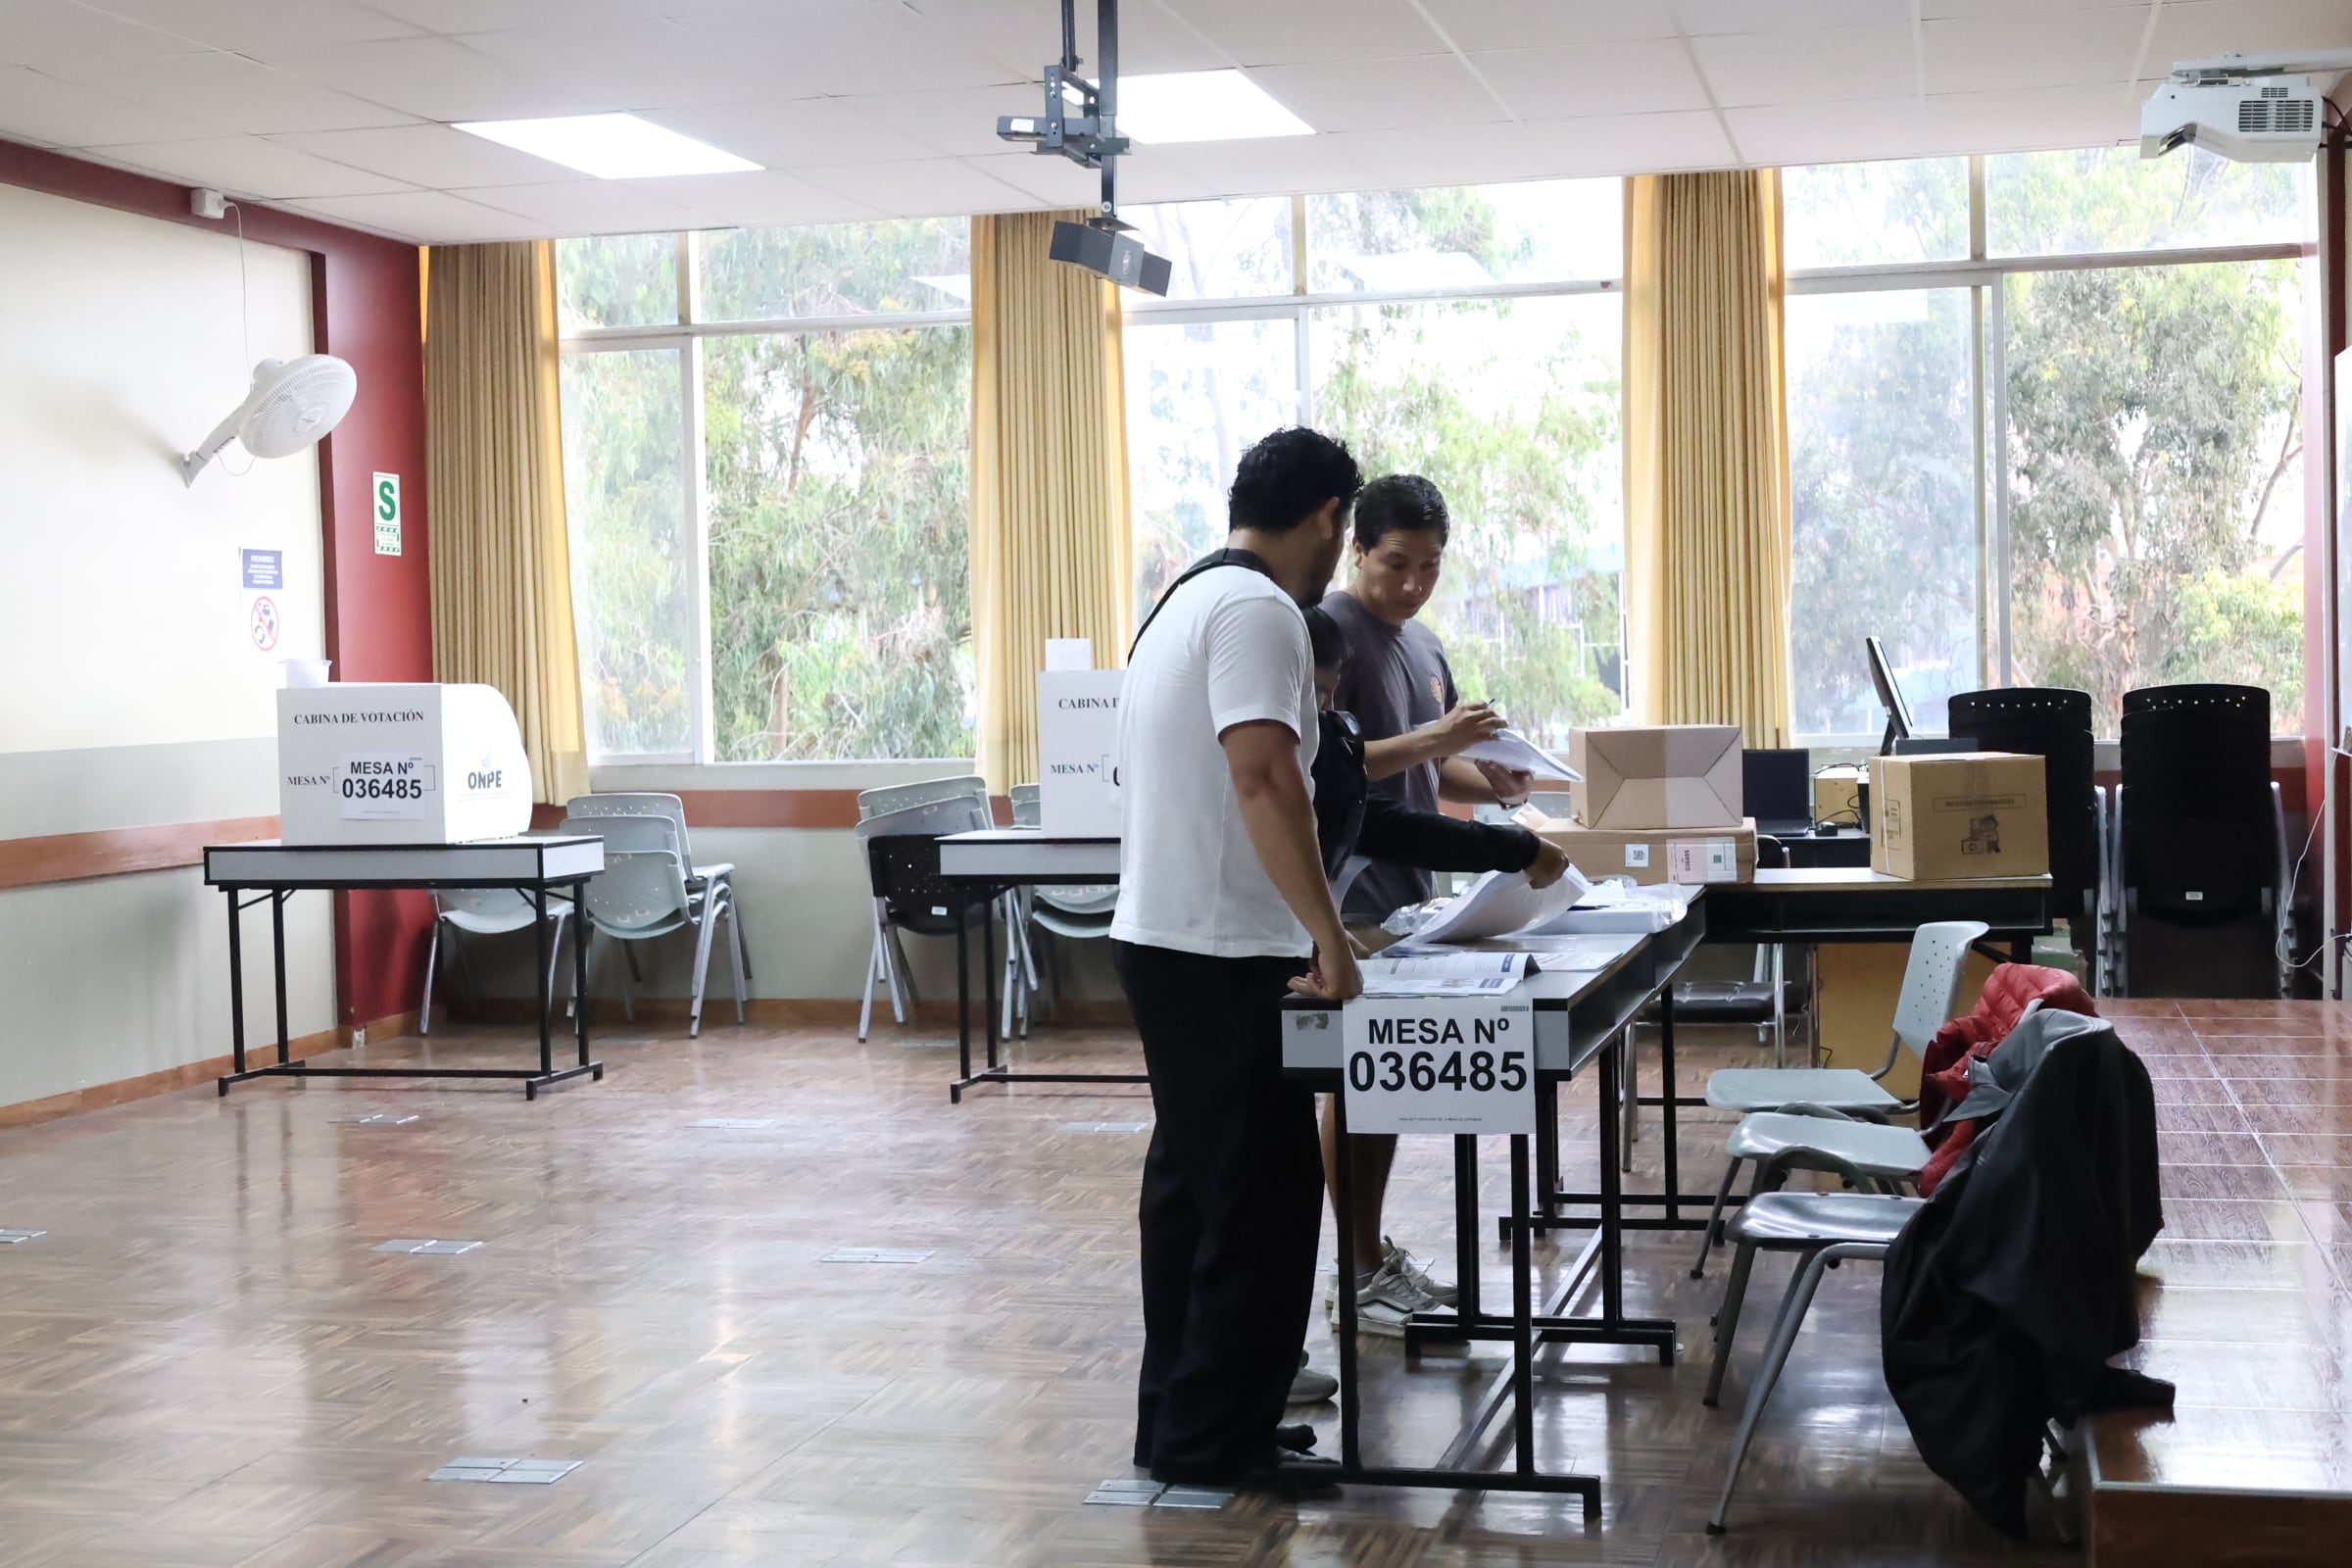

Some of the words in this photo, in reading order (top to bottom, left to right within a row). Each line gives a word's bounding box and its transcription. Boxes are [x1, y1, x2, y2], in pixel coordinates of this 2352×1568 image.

[378, 480, 396, 521] S
[1058, 697, 1109, 710] CABINA
[294, 712, 339, 725] CABINA
[342, 712, 358, 724] DE
[361, 709, 424, 723] VOTACIÓN
[350, 761, 394, 775] MESA
[1051, 763, 1084, 774] MESA
[287, 776, 318, 786] MESA
[342, 778, 422, 800] 036485
[467, 770, 502, 790] ONPE
[1368, 1018, 1464, 1045] MESA
[1348, 1051, 1528, 1093] 036485
